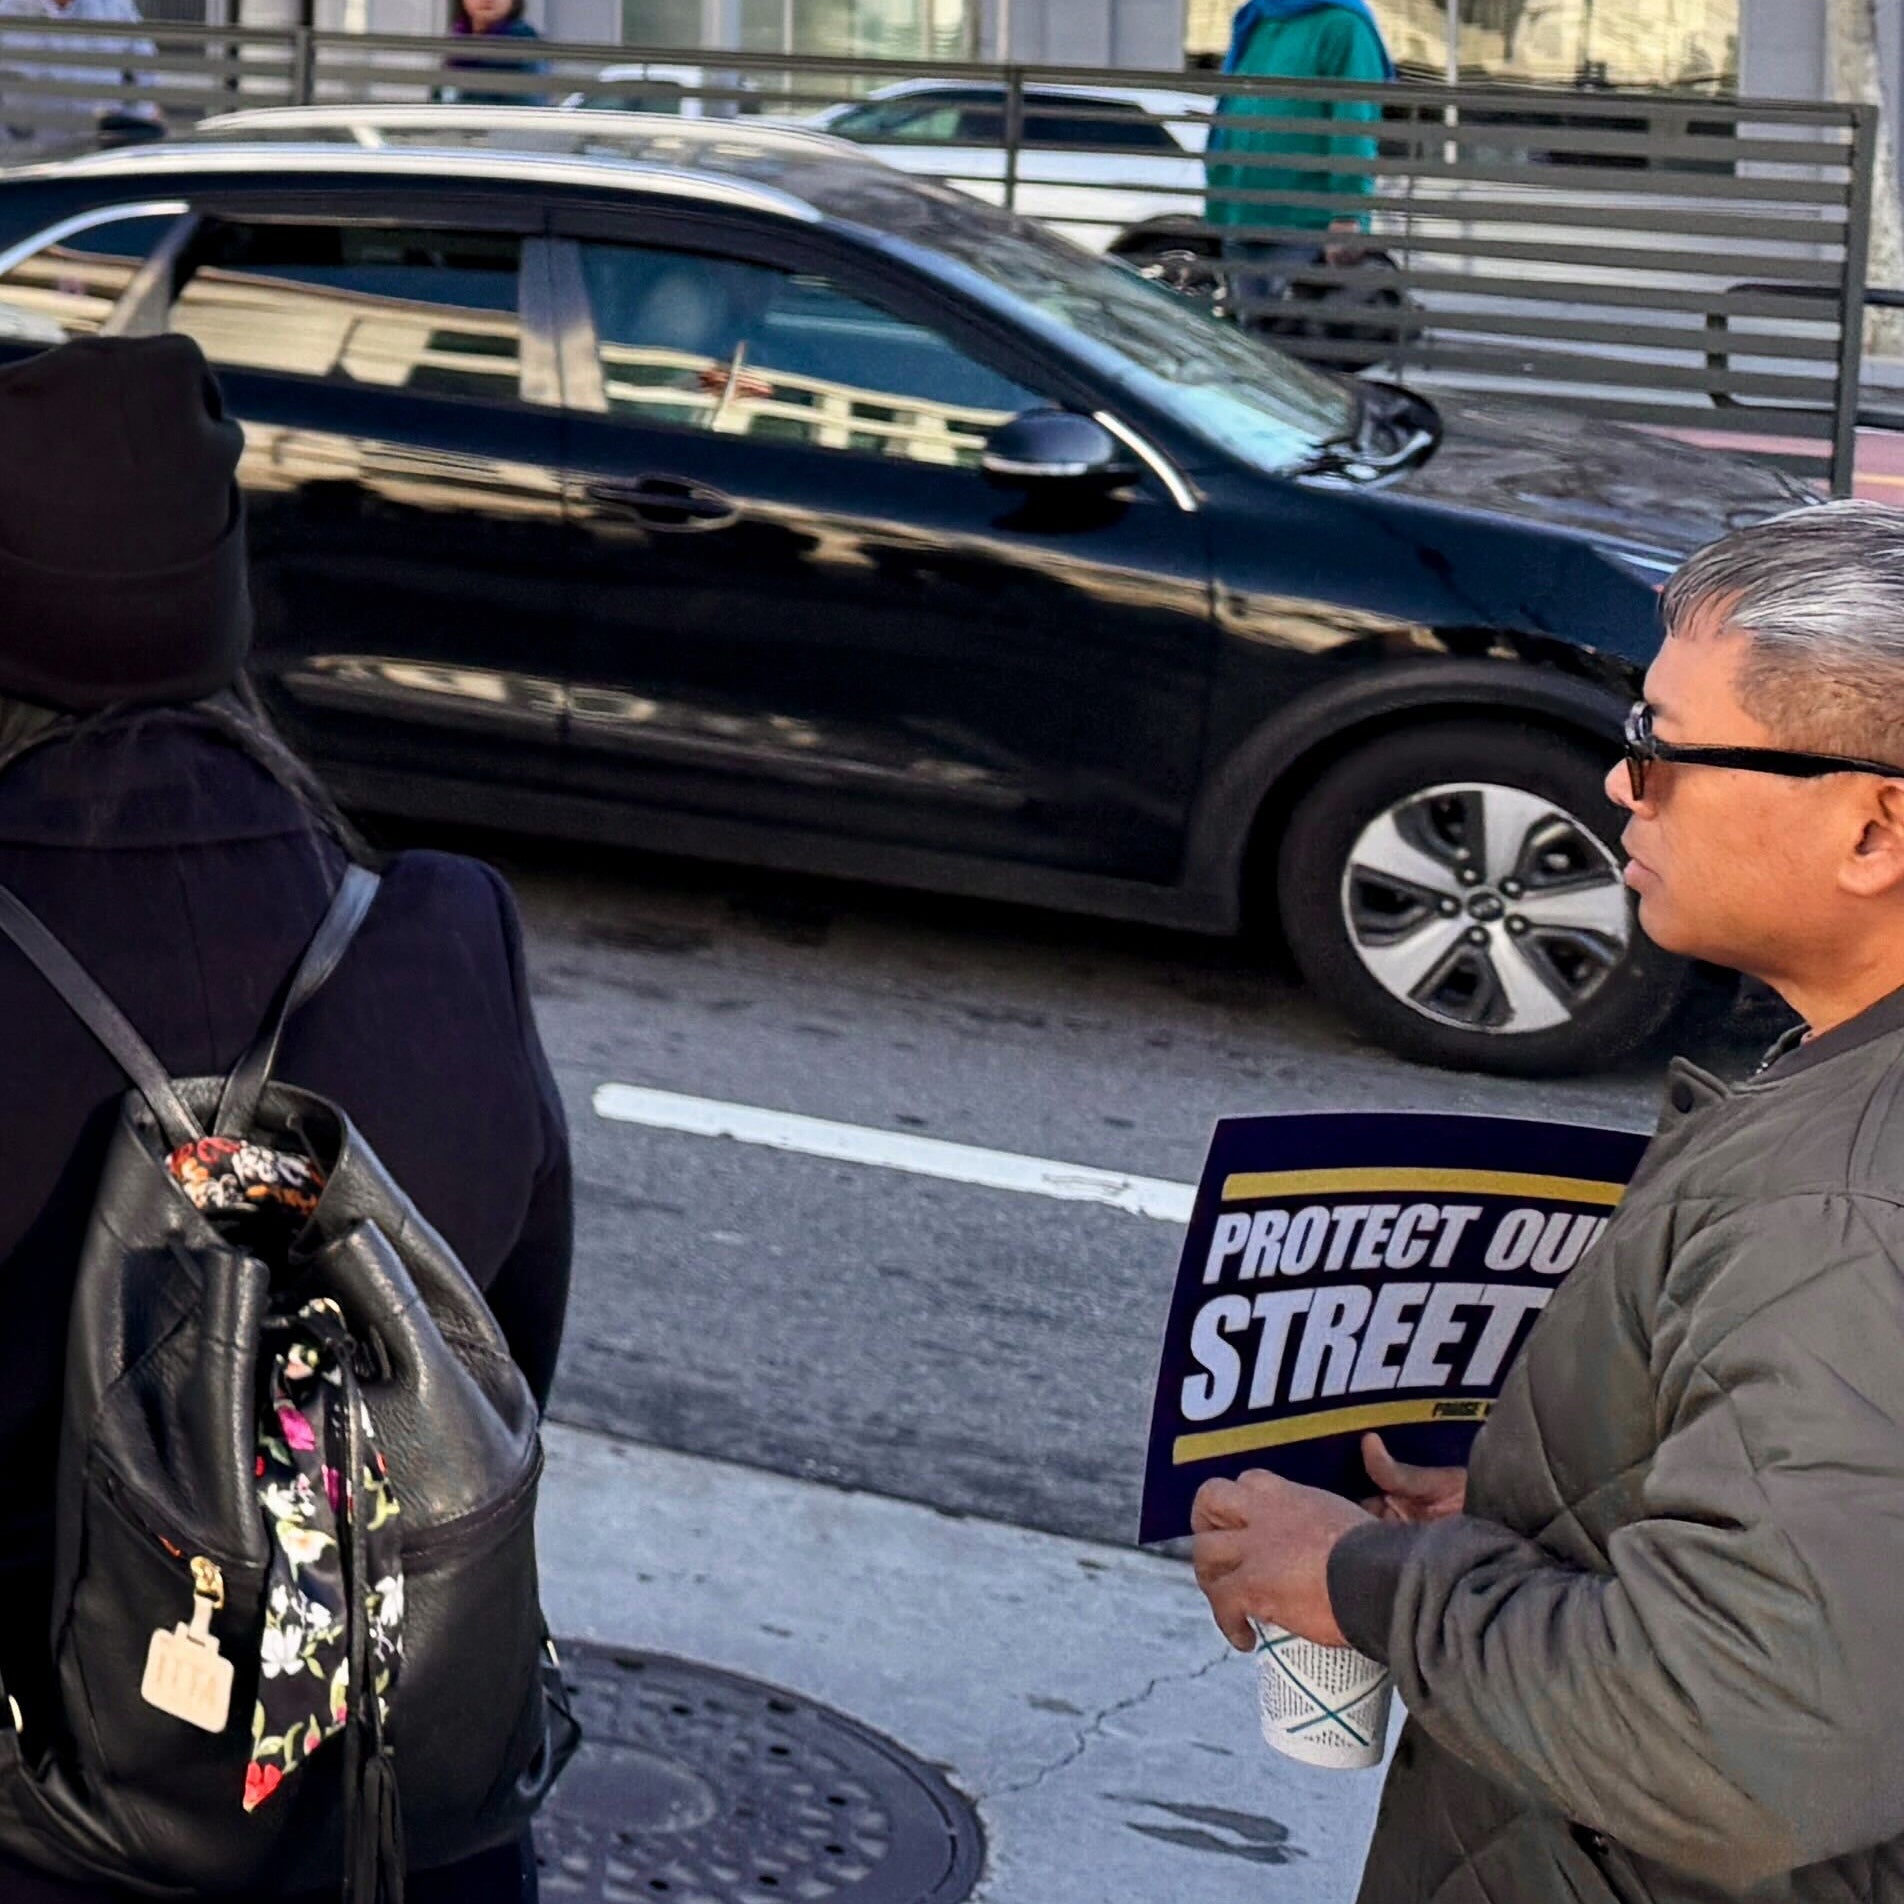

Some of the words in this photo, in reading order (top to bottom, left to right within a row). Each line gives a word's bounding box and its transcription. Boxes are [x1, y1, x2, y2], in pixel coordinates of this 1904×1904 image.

[1202, 1203, 1483, 1285] PROTECT
[1483, 1208, 1609, 1274] OU
[1180, 1282, 1556, 1422] STREET
